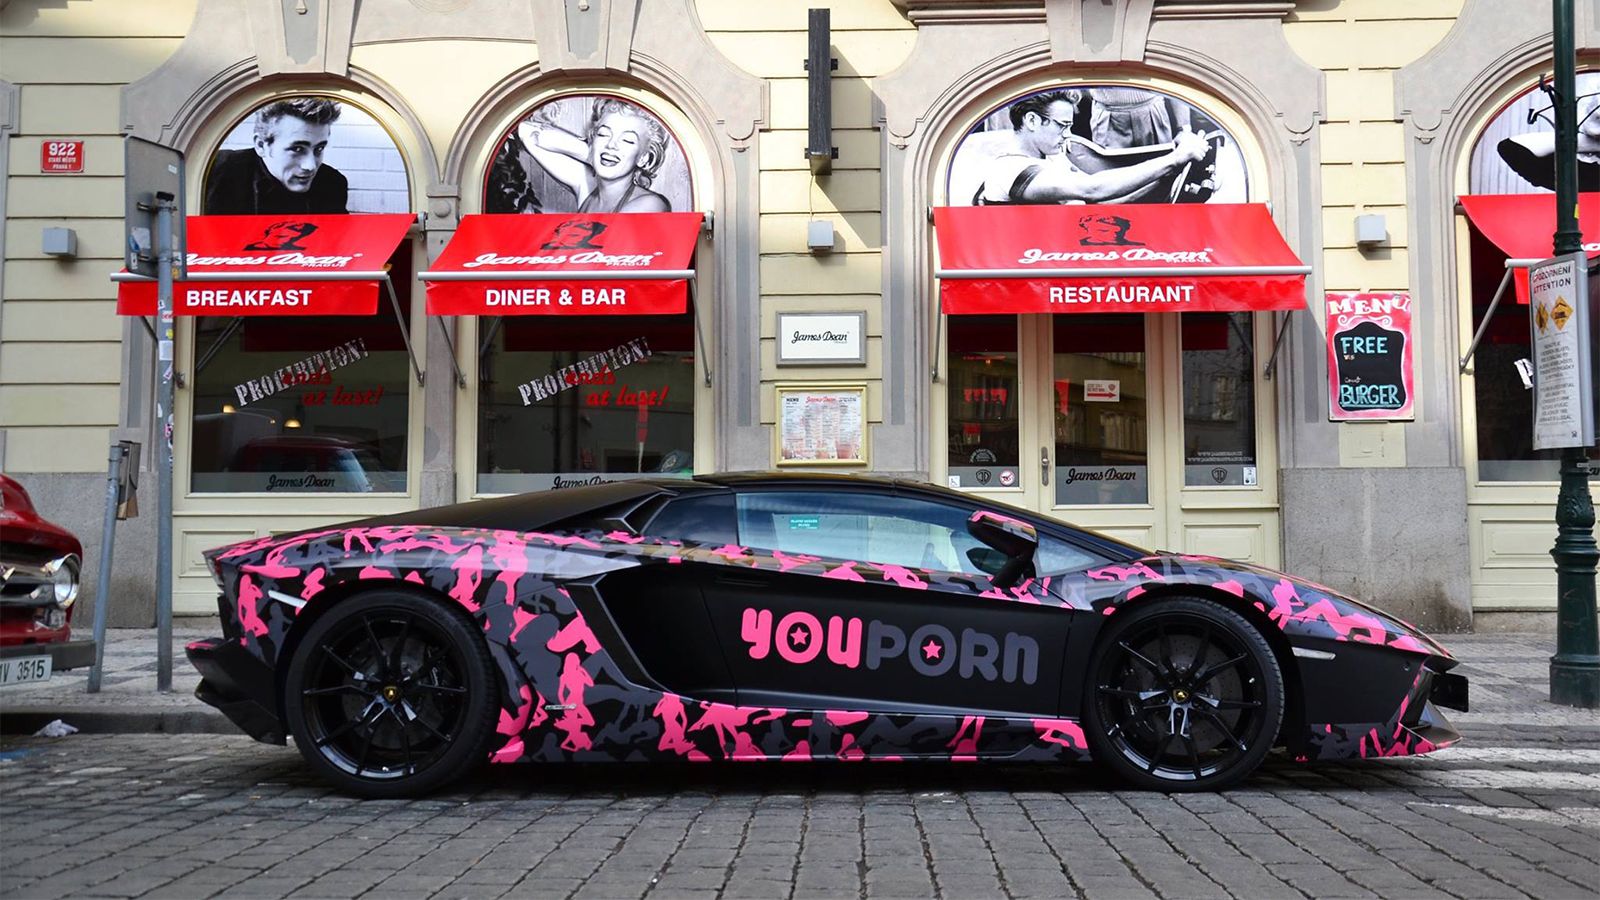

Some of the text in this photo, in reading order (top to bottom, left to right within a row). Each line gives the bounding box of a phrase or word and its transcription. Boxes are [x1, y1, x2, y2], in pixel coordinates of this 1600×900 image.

[49, 143, 76, 156] 922
[267, 252, 352, 266] Dean
[463, 251, 653, 268] James Dean
[1018, 248, 1207, 264] James Dean
[186, 290, 312, 307] BREAKFAST
[486, 288, 626, 306] DINER & BAR
[1050, 286, 1194, 303] RESTAURANT
[1328, 297, 1411, 315] MENU
[791, 330, 848, 344] James Dean
[1340, 337, 1388, 354] FREE
[303, 384, 384, 406] at last!
[586, 384, 670, 406] at last!
[1340, 384, 1400, 405] BURGER
[266, 474, 336, 491] James Dean
[551, 475, 588, 490] James
[1066, 467, 1136, 484] James Dean
[741, 607, 1040, 685] YOUPORN
[17, 660, 46, 680] 3515
